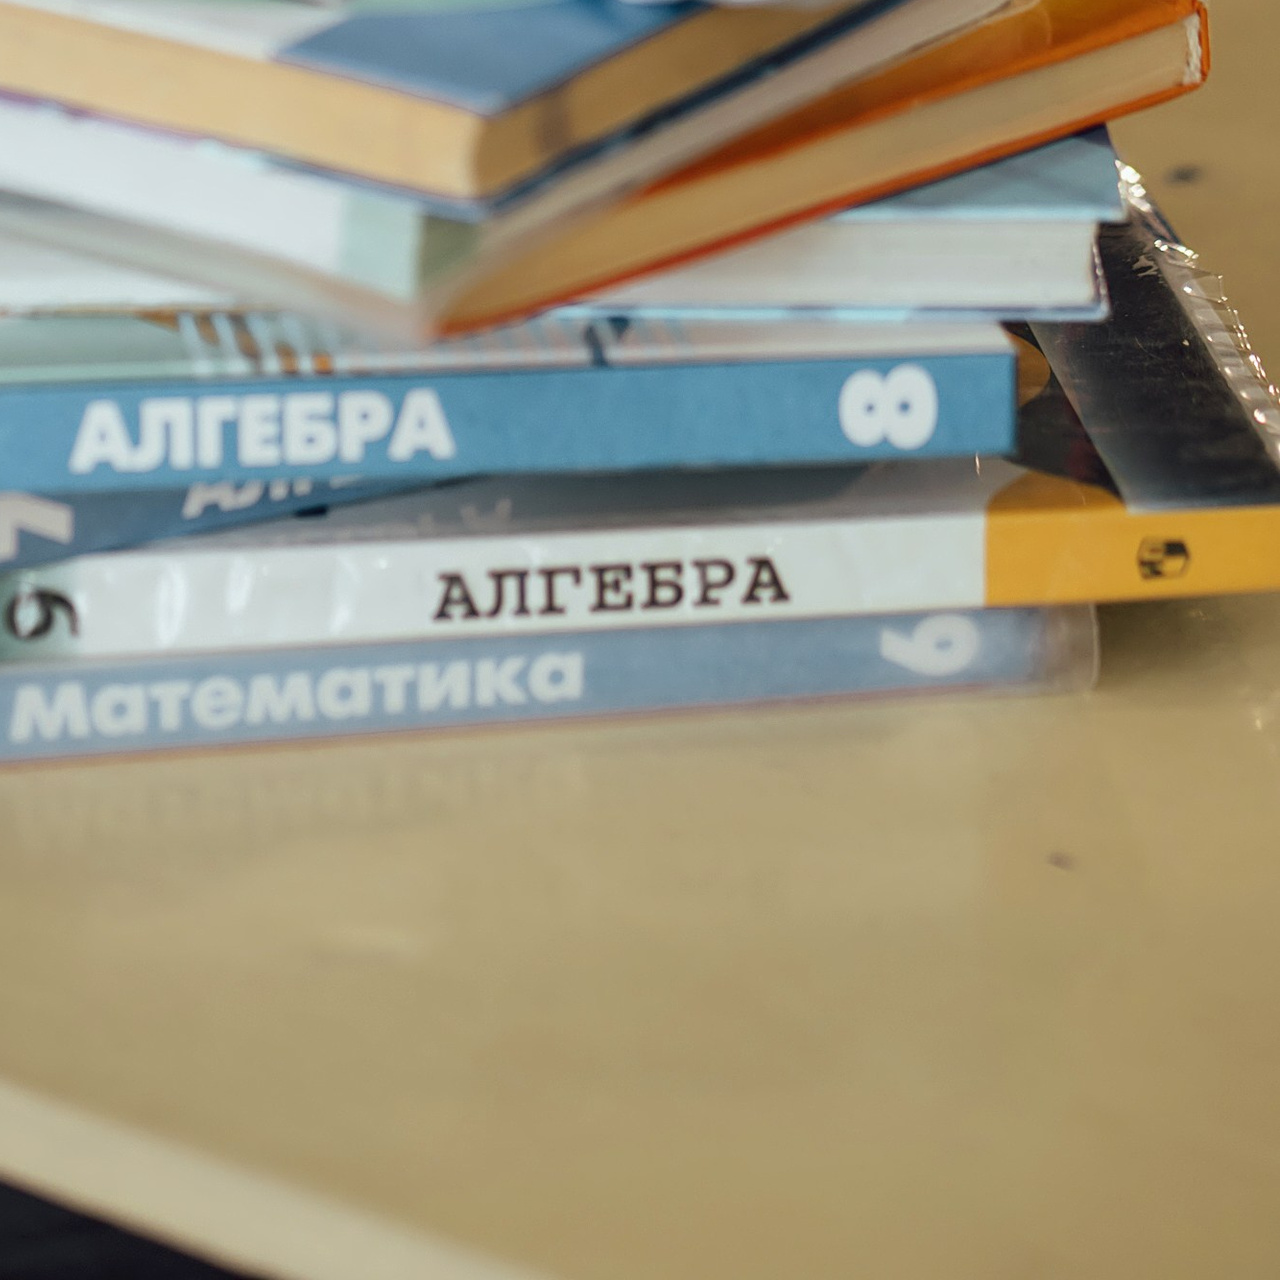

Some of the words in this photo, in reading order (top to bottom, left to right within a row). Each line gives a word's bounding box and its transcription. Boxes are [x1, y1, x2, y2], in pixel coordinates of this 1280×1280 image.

[69, 387, 457, 475] АЛГЕБРА
[837, 363, 939, 450] 8
[432, 556, 790, 622] АЛГЕБРА
[10, 651, 585, 742] Математика
